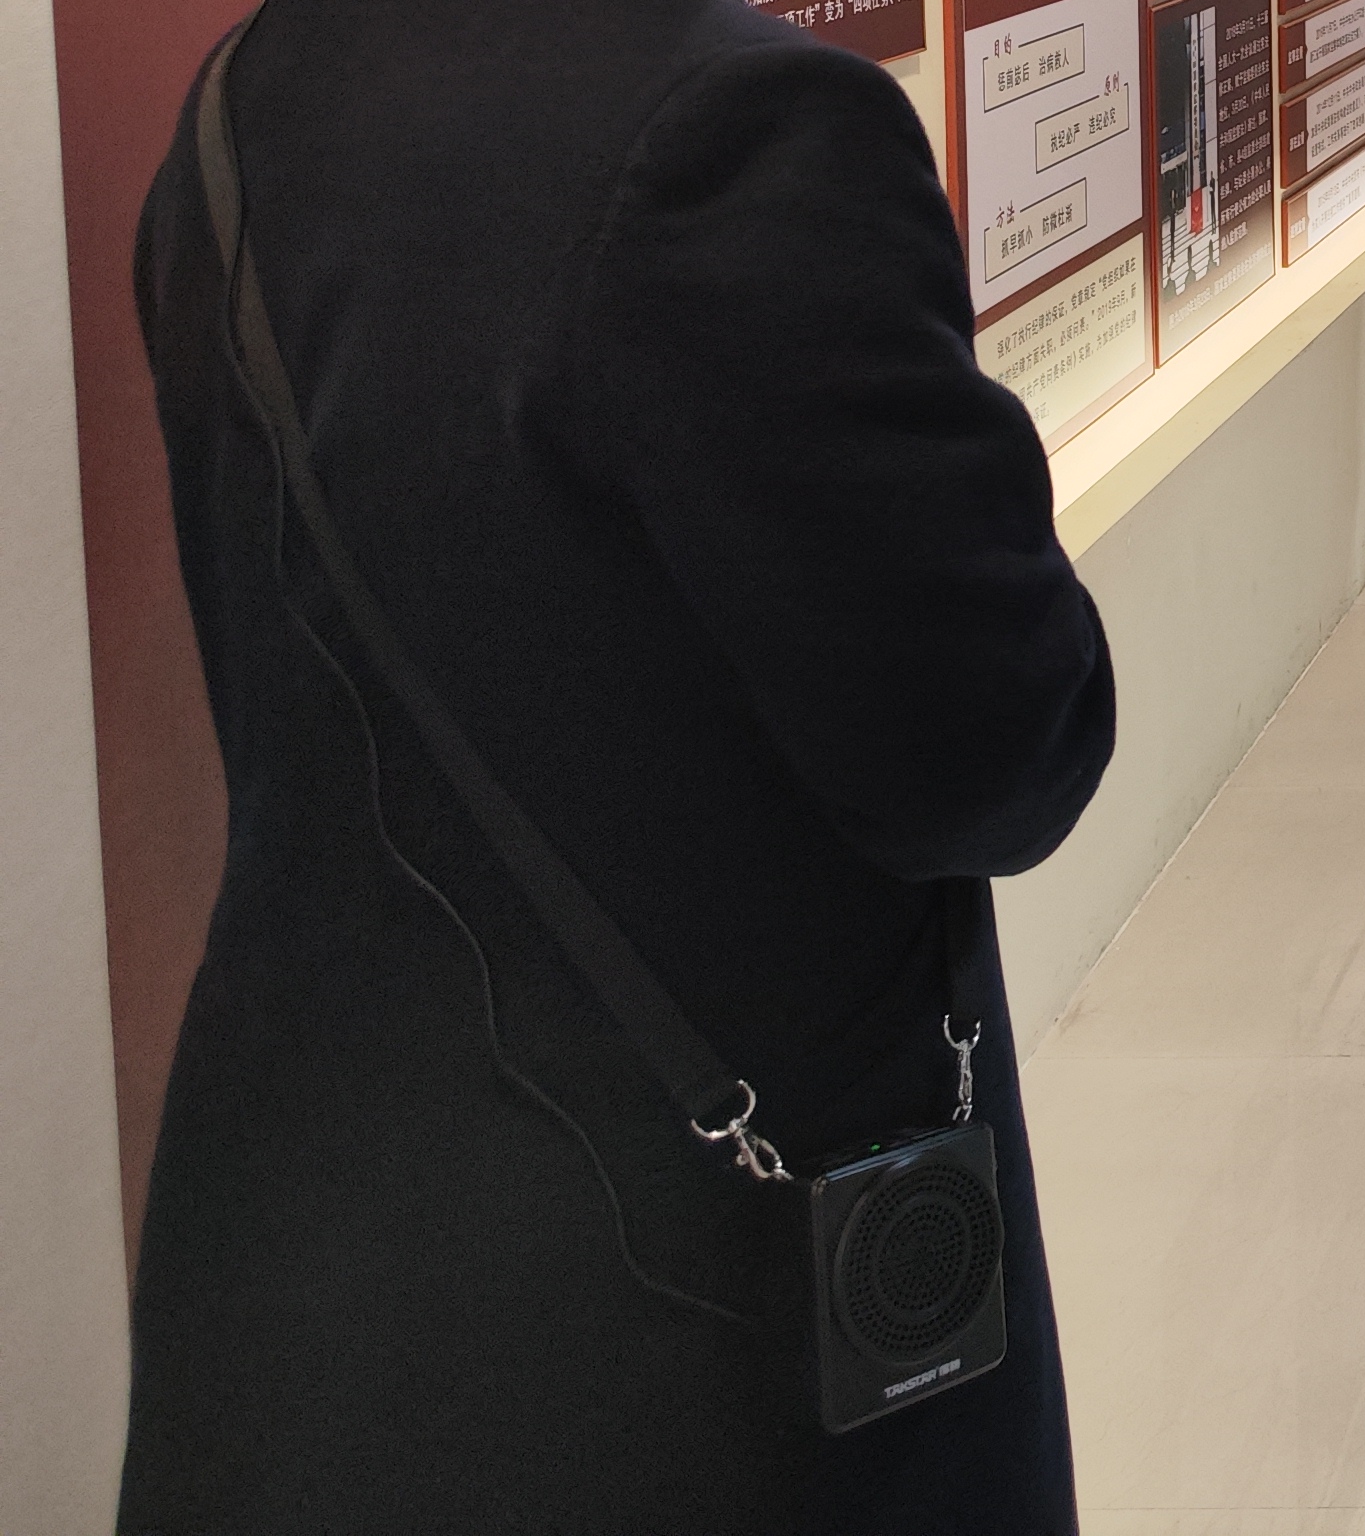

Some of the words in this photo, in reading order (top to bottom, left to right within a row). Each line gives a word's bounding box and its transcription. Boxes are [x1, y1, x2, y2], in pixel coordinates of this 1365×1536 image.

[993, 34, 1013, 57] 目的
[1038, 47, 1071, 77] 治病救人
[1103, 71, 1121, 97] 原则
[1088, 107, 1118, 136] 违纪必究
[1050, 121, 1081, 154] 执纪必严
[996, 200, 1016, 228] 方法
[1041, 203, 1073, 237] 防微杜渐
[1001, 225, 1034, 260] 抓早抓小
